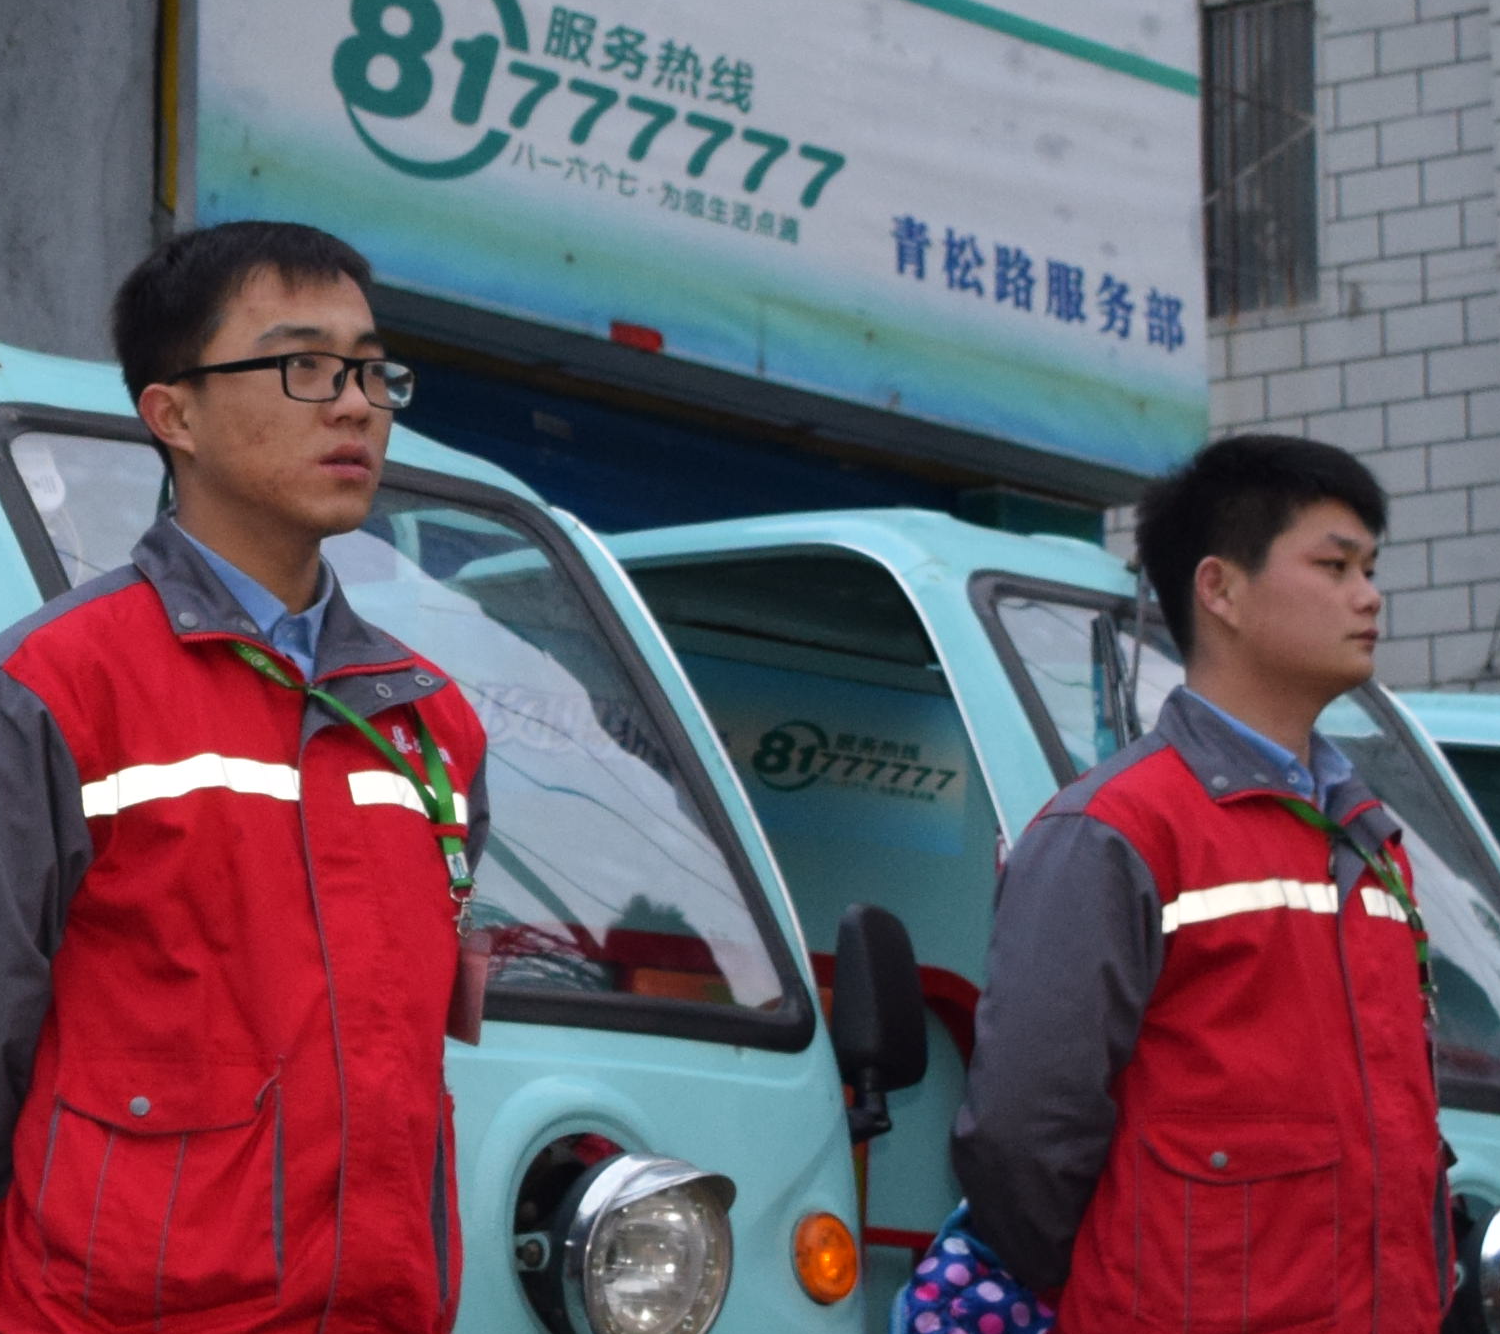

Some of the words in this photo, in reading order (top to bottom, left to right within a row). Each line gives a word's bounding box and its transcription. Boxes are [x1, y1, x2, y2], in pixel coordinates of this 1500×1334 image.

[543, 4, 755, 114] 服务热线
[892, 214, 1187, 354] 青松路服务部
[752, 729, 957, 792] 81777777
